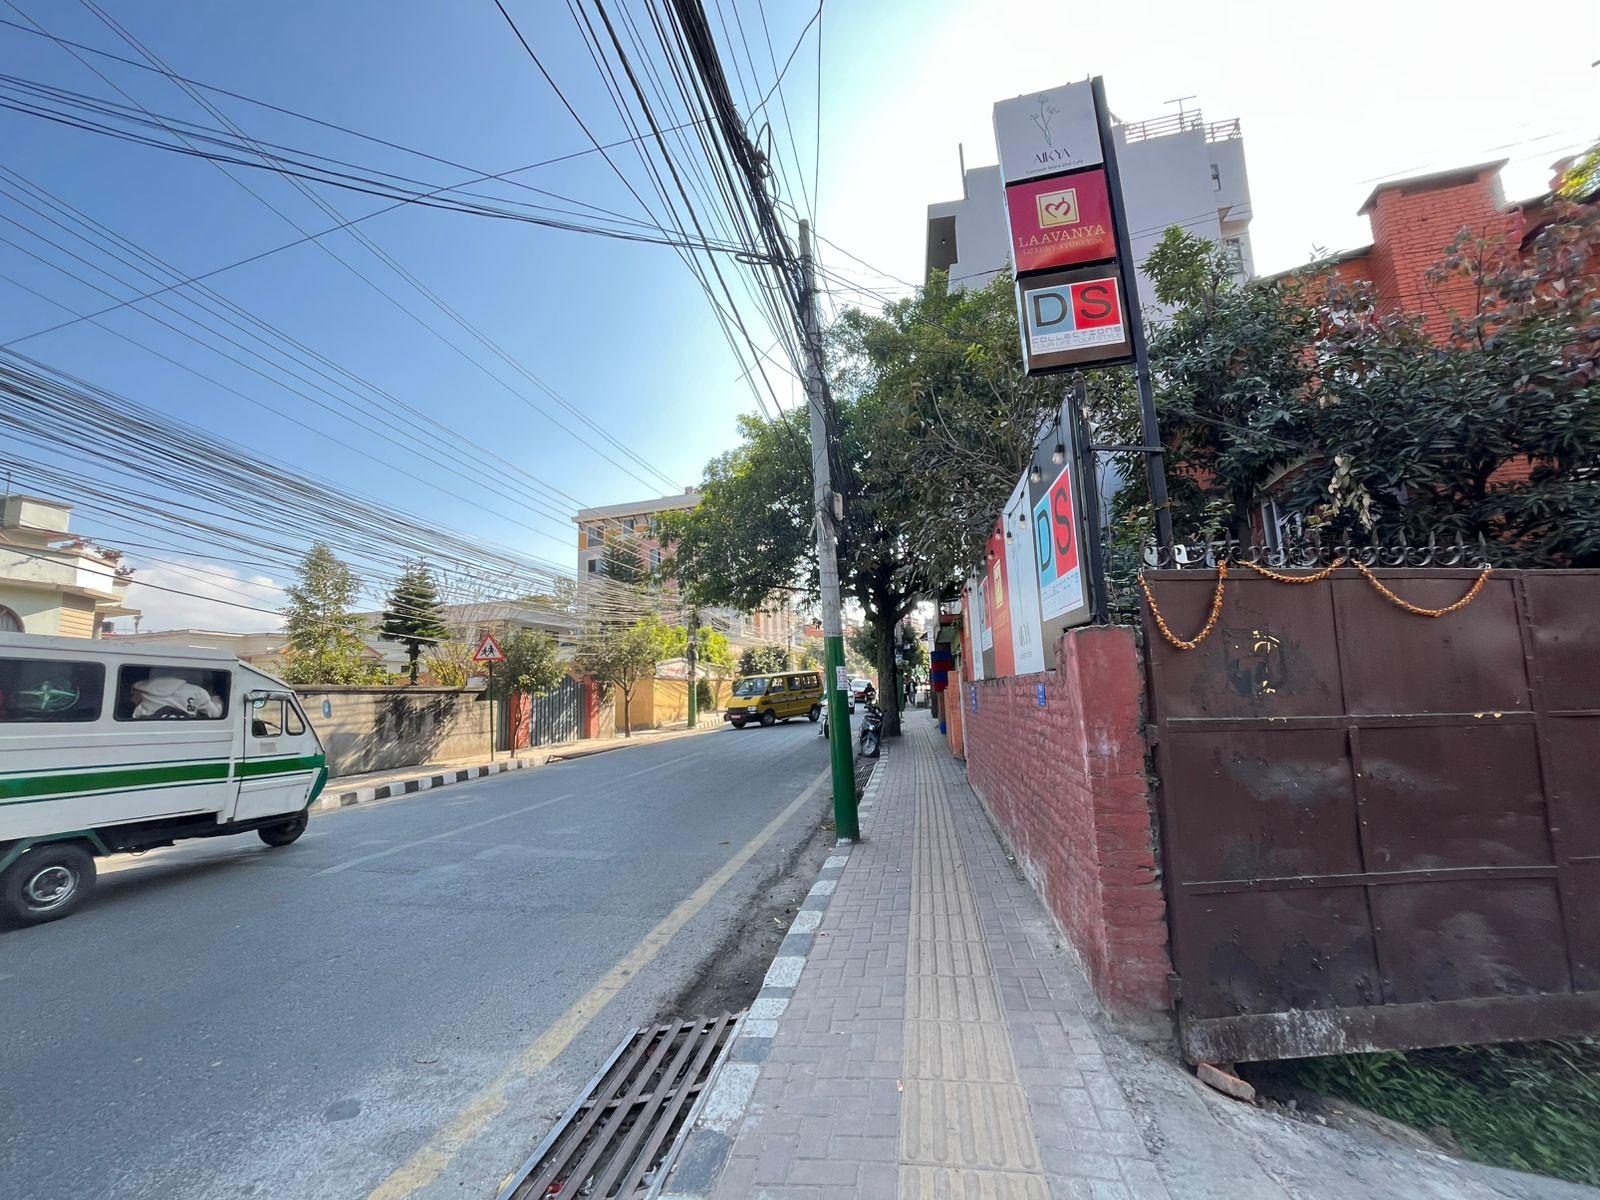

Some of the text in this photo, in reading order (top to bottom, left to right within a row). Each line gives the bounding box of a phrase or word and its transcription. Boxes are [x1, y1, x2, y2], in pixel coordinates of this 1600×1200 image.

[1034, 148, 1071, 165] AIKYA
[1018, 224, 1107, 248] LAAVANYA
[1033, 285, 1112, 328] DS
